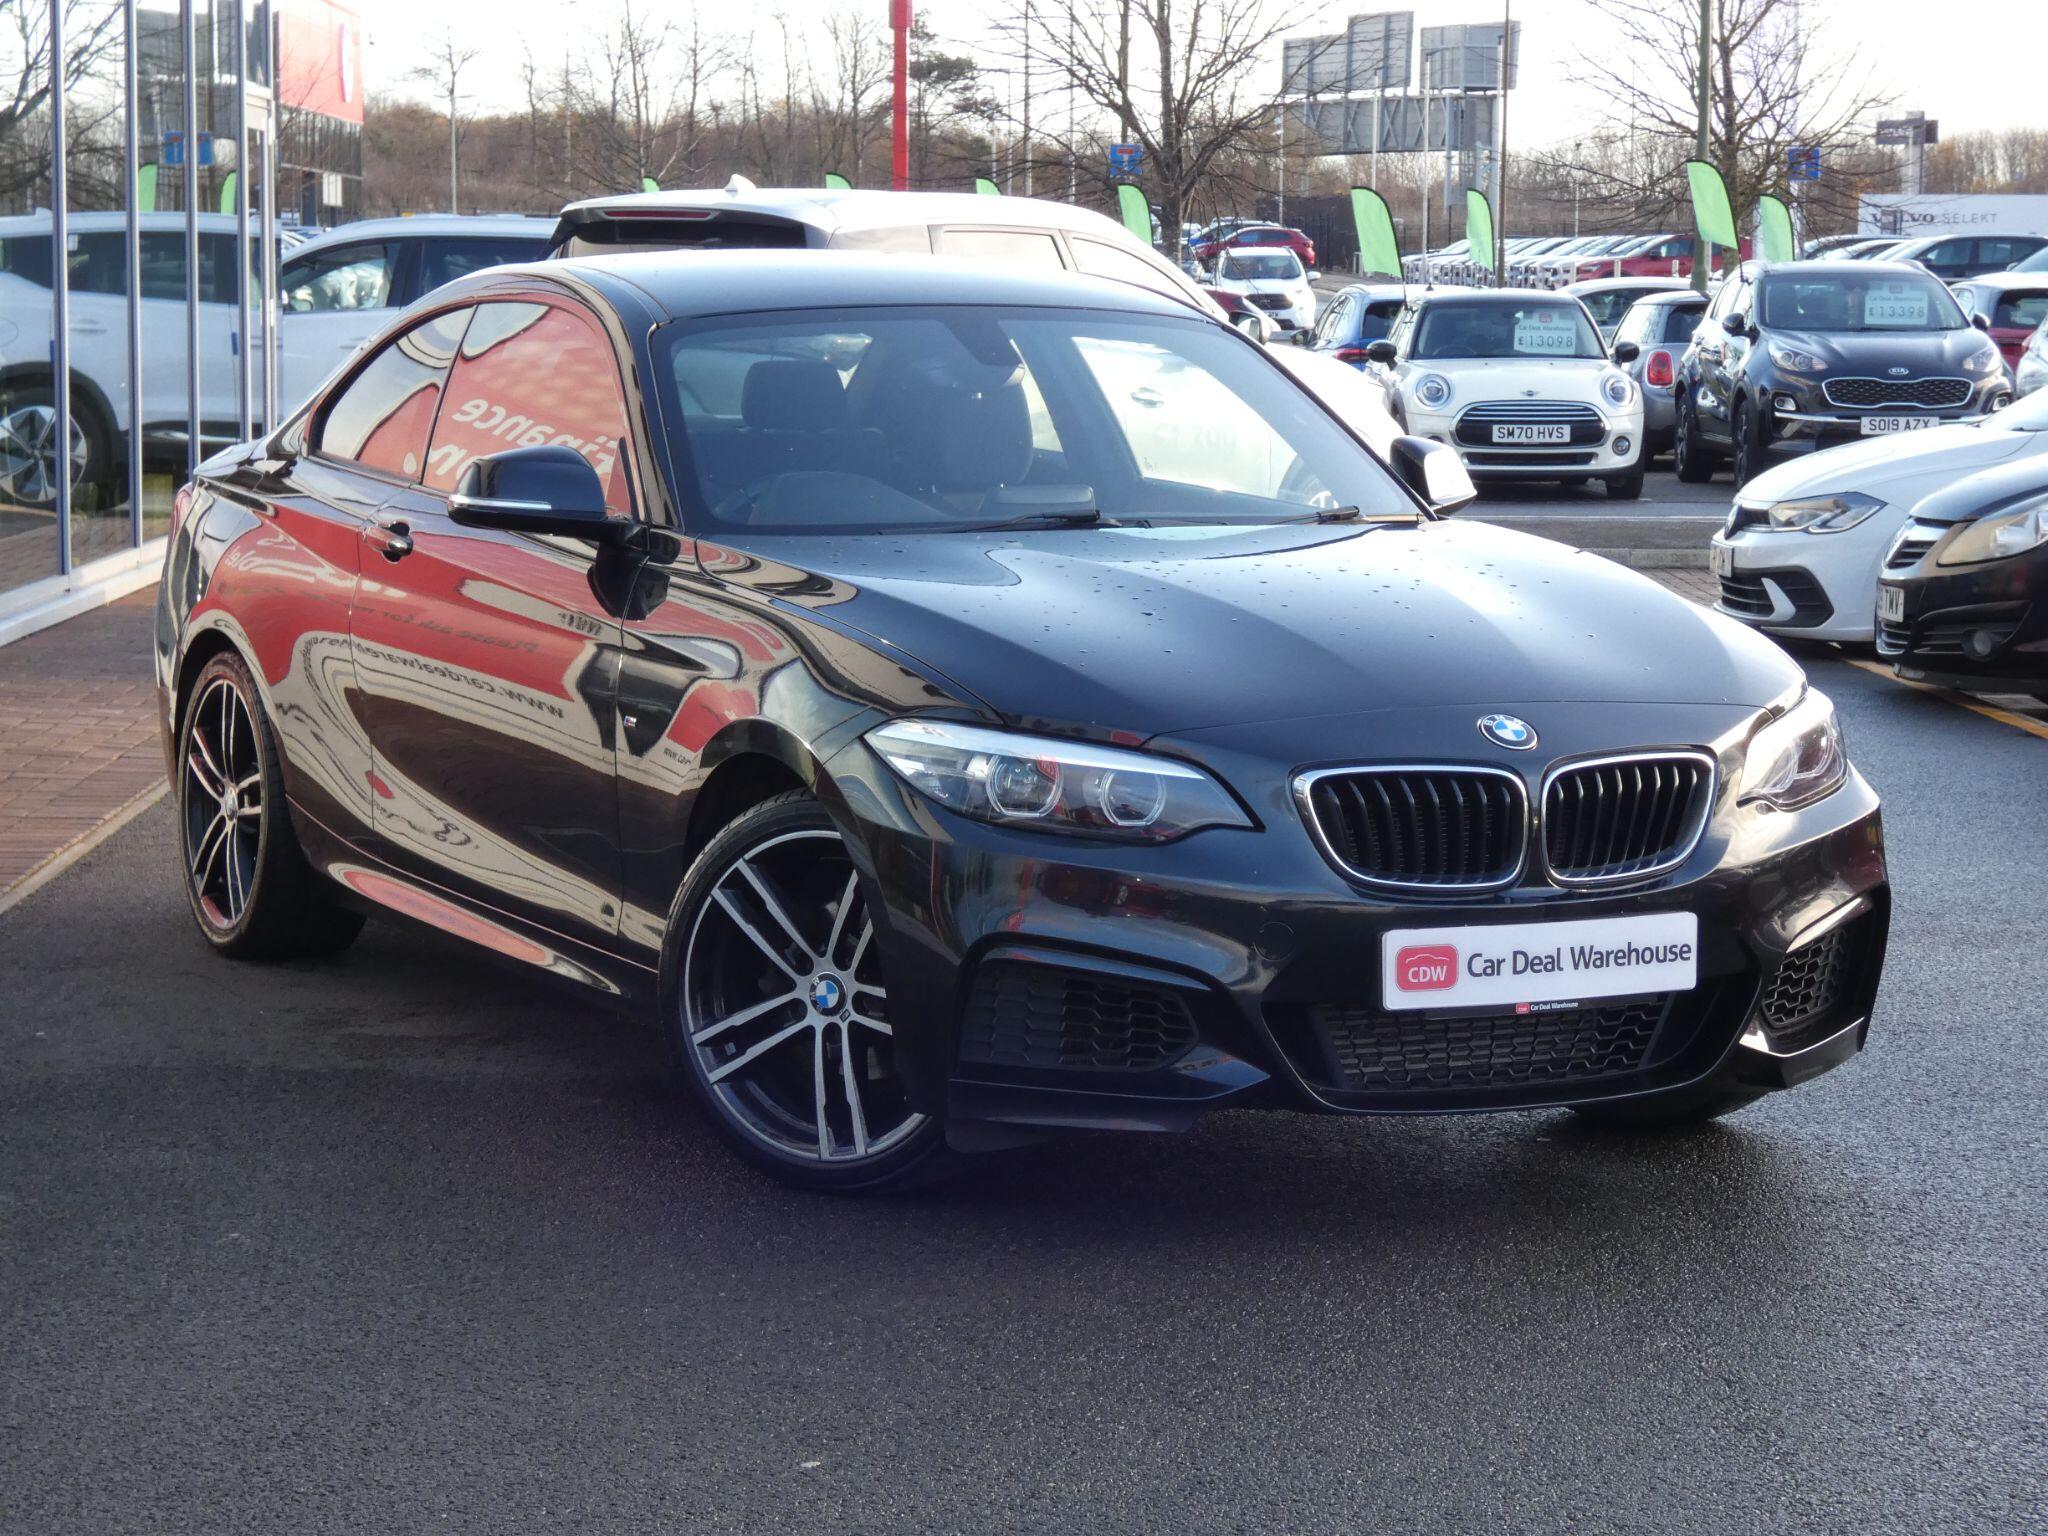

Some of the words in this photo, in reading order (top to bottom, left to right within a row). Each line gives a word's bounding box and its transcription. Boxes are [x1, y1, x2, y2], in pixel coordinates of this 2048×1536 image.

[1944, 212, 1998, 224] SELEKT
[1868, 418, 1900, 432] SO19
[1497, 426, 1534, 440] SM70
[1537, 426, 1565, 440] HVS
[1467, 953, 1506, 977] Car
[1512, 948, 1564, 975] Deal
[1570, 942, 1692, 970] Warehouse
[1408, 965, 1448, 983] CDW
